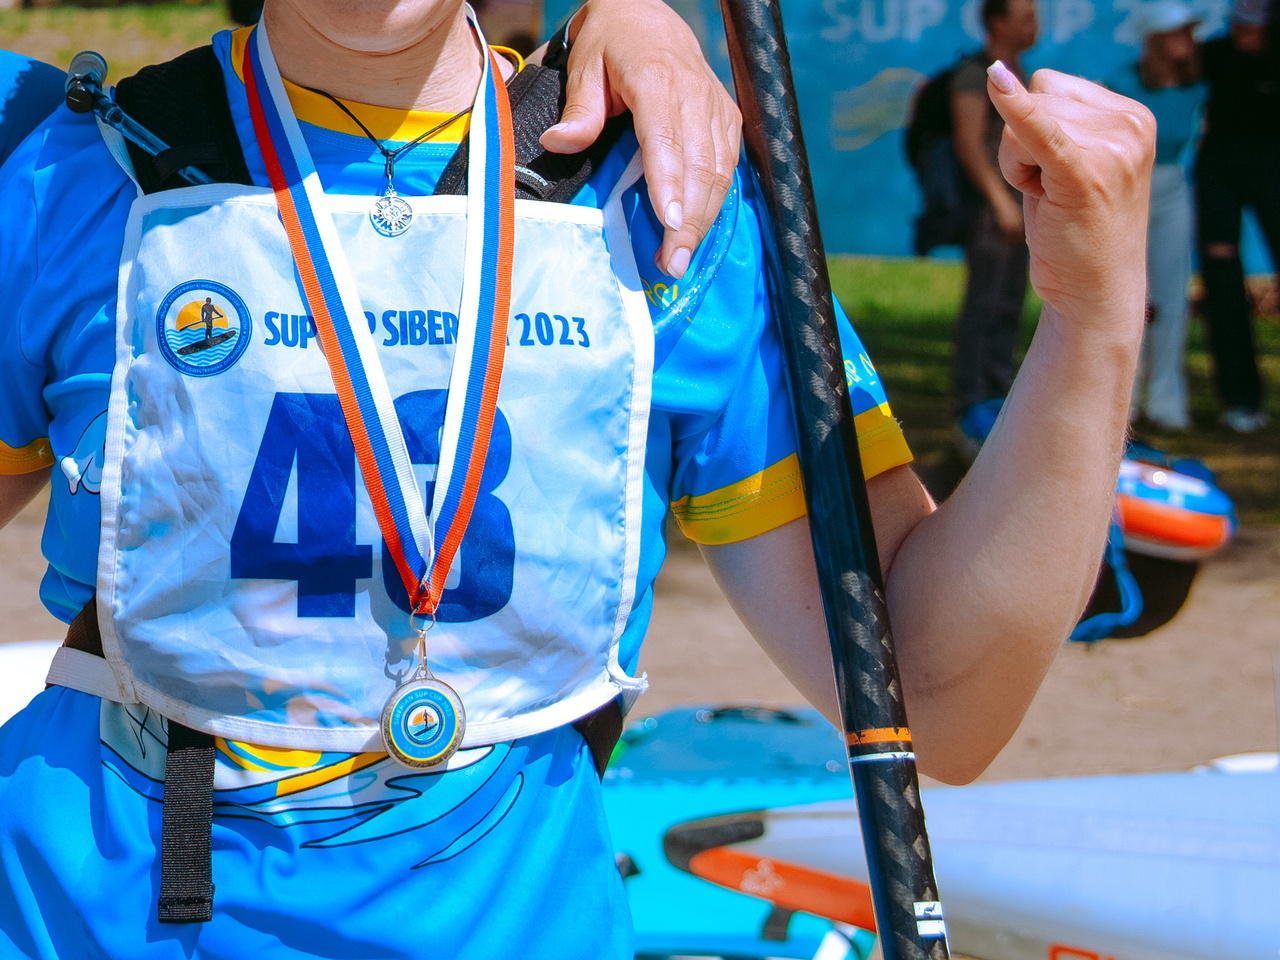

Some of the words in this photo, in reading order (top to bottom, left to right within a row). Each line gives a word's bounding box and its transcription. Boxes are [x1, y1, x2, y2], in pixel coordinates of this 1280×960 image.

[263, 311, 318, 349] SUP
[382, 309, 508, 347] SIBER
[514, 312, 591, 348] 2023
[394, 694, 414, 725] SIBERIAN
[414, 691, 428, 699] SUP
[429, 691, 443, 701] CUP
[441, 701, 453, 717] 2023
